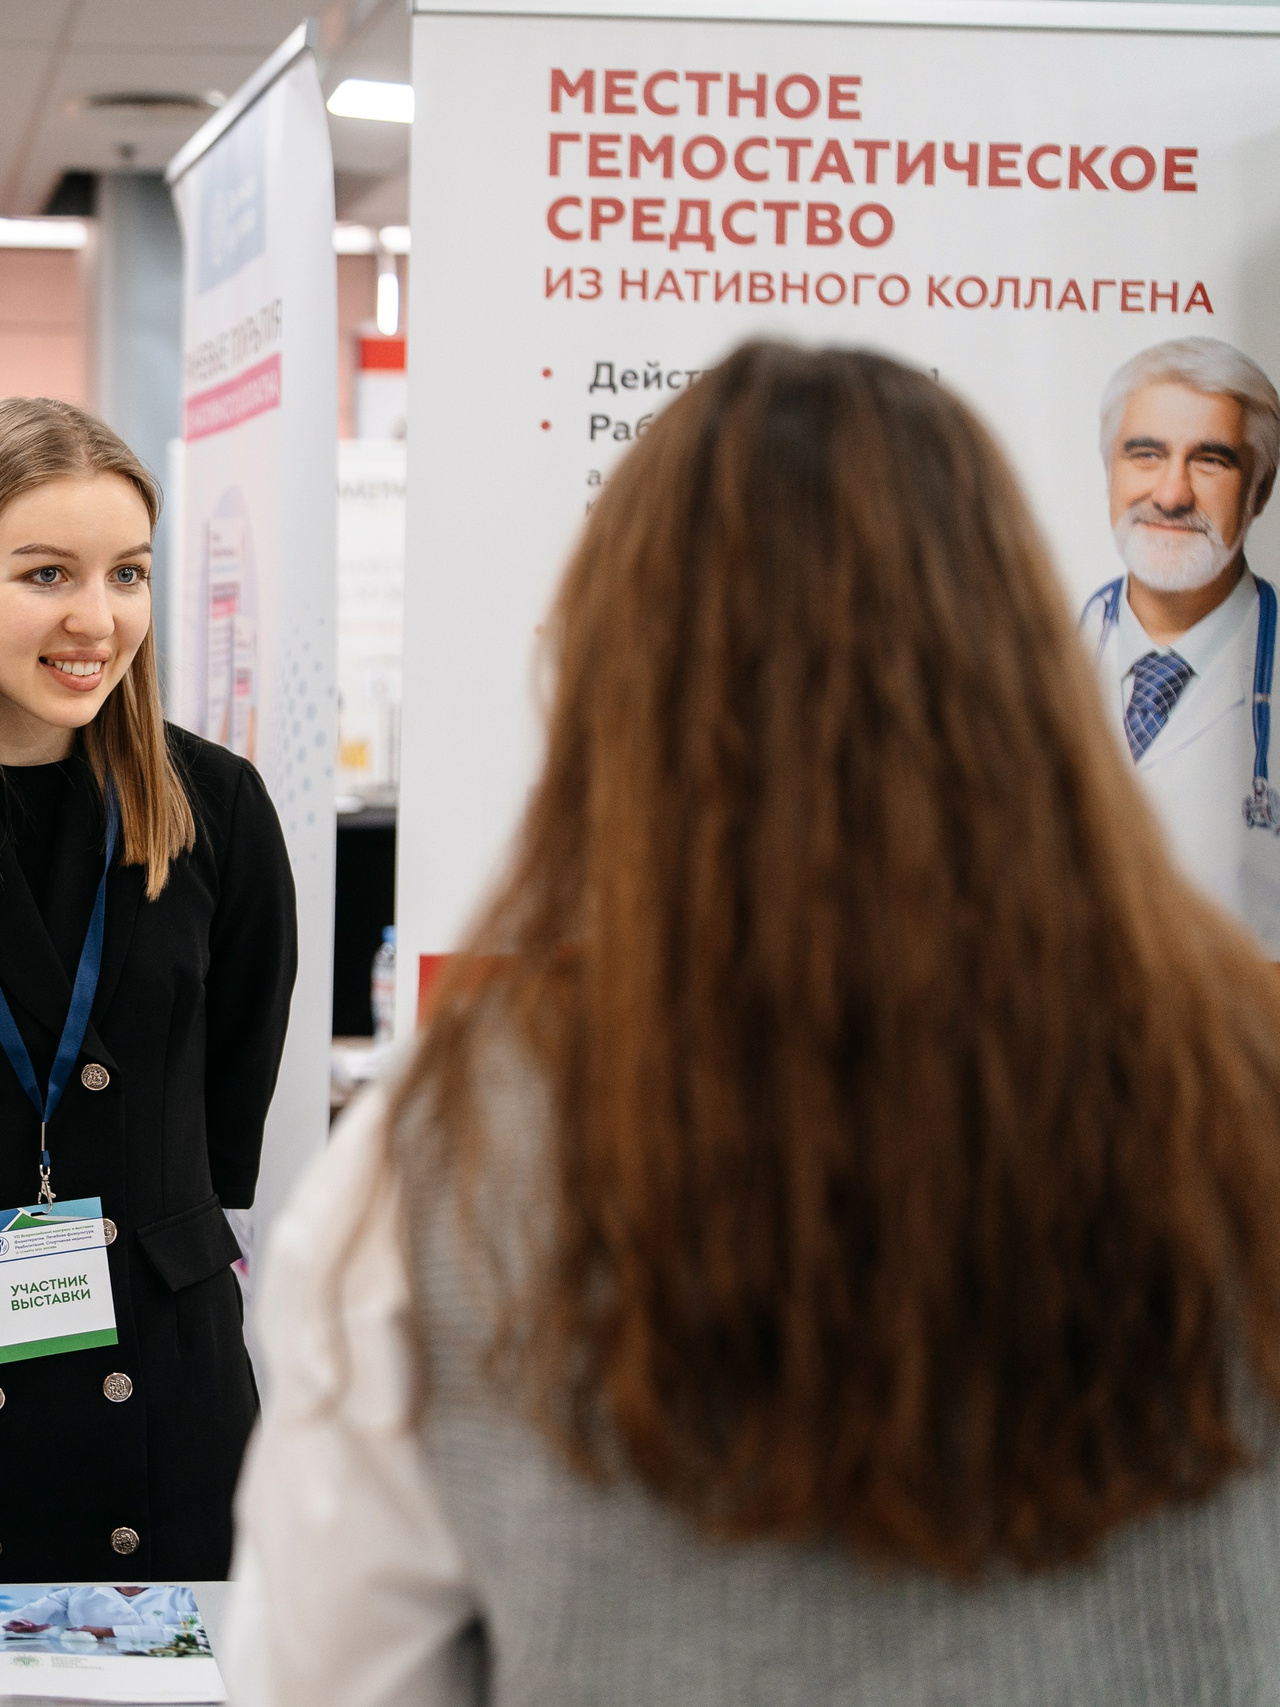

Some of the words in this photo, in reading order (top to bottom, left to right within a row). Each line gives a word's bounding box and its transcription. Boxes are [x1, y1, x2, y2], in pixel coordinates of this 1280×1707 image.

[549, 67, 862, 121] МЕСТНОЕ
[547, 131, 1198, 193] ГЕМОСТАТИЧЕСКОЕ
[545, 195, 895, 254] СРЕДСТВО
[544, 266, 603, 301] ИЗ
[619, 268, 911, 308] НАТИВНОГО
[926, 275, 1214, 315] КОЛЛАГЕНА
[10, 1273, 89, 1297] УЧАСТНИК
[11, 1288, 91, 1311] ВЫСТАВКИ
